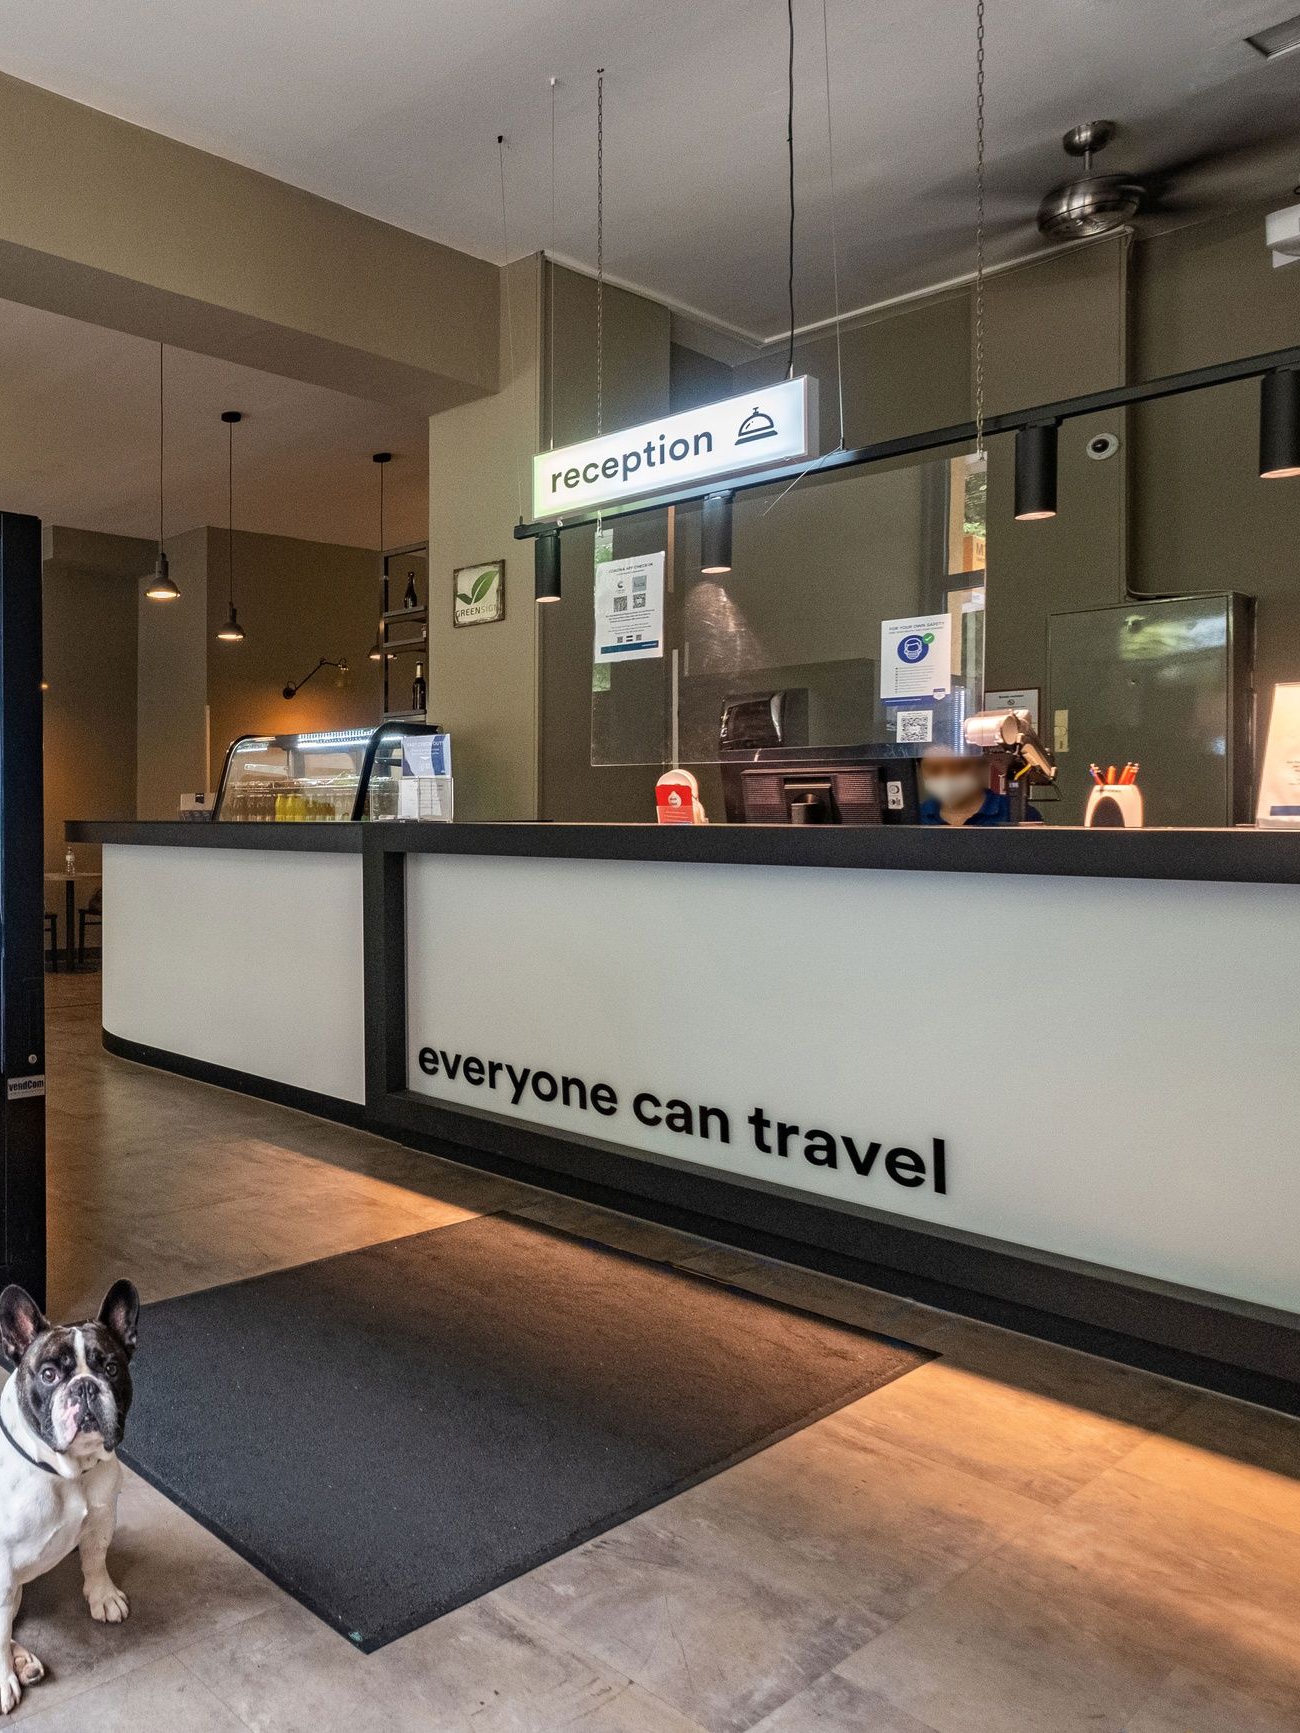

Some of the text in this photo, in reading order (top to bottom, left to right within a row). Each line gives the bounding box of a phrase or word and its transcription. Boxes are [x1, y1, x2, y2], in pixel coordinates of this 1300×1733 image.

[551, 430, 713, 493] reception
[9, 1080, 44, 1091] vendCom
[418, 1045, 948, 1195] everyone can travel
